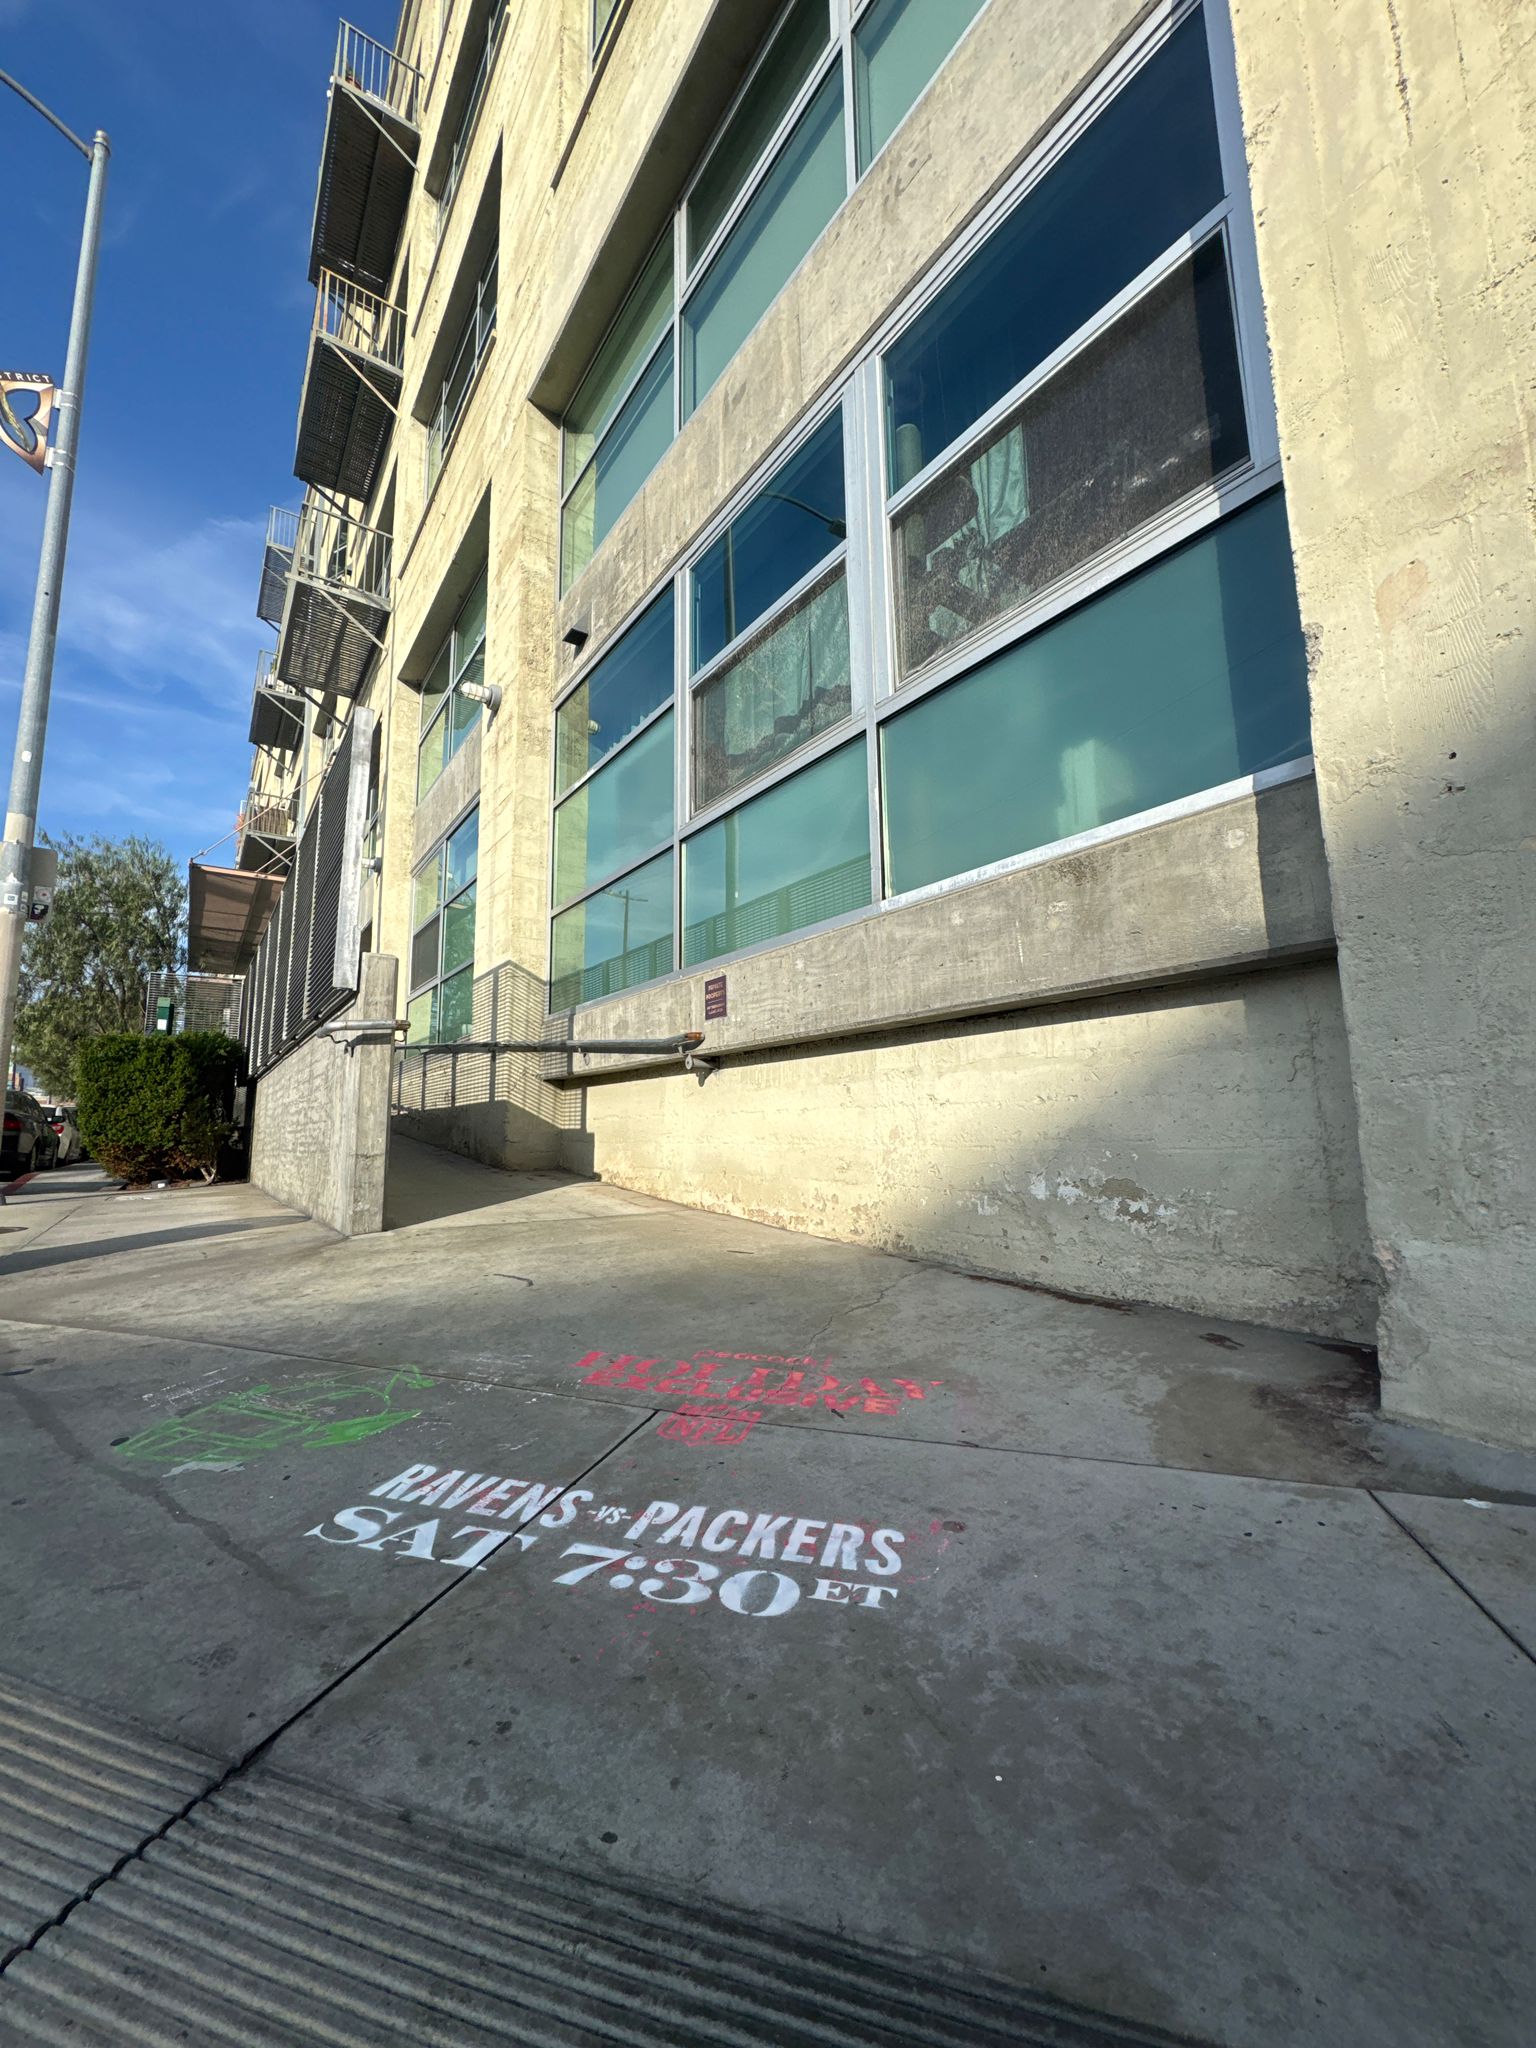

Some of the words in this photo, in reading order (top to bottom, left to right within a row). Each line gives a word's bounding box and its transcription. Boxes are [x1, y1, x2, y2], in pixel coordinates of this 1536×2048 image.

[580, 1370, 900, 1415] EXCLUSIVE
[668, 1416, 738, 1442] NFL
[367, 1463, 594, 1529] RAVENS
[624, 1501, 905, 1576] PACKERS
[304, 1505, 538, 1571] SAT
[552, 1543, 801, 1617] 7:30
[807, 1578, 899, 1609] ET
